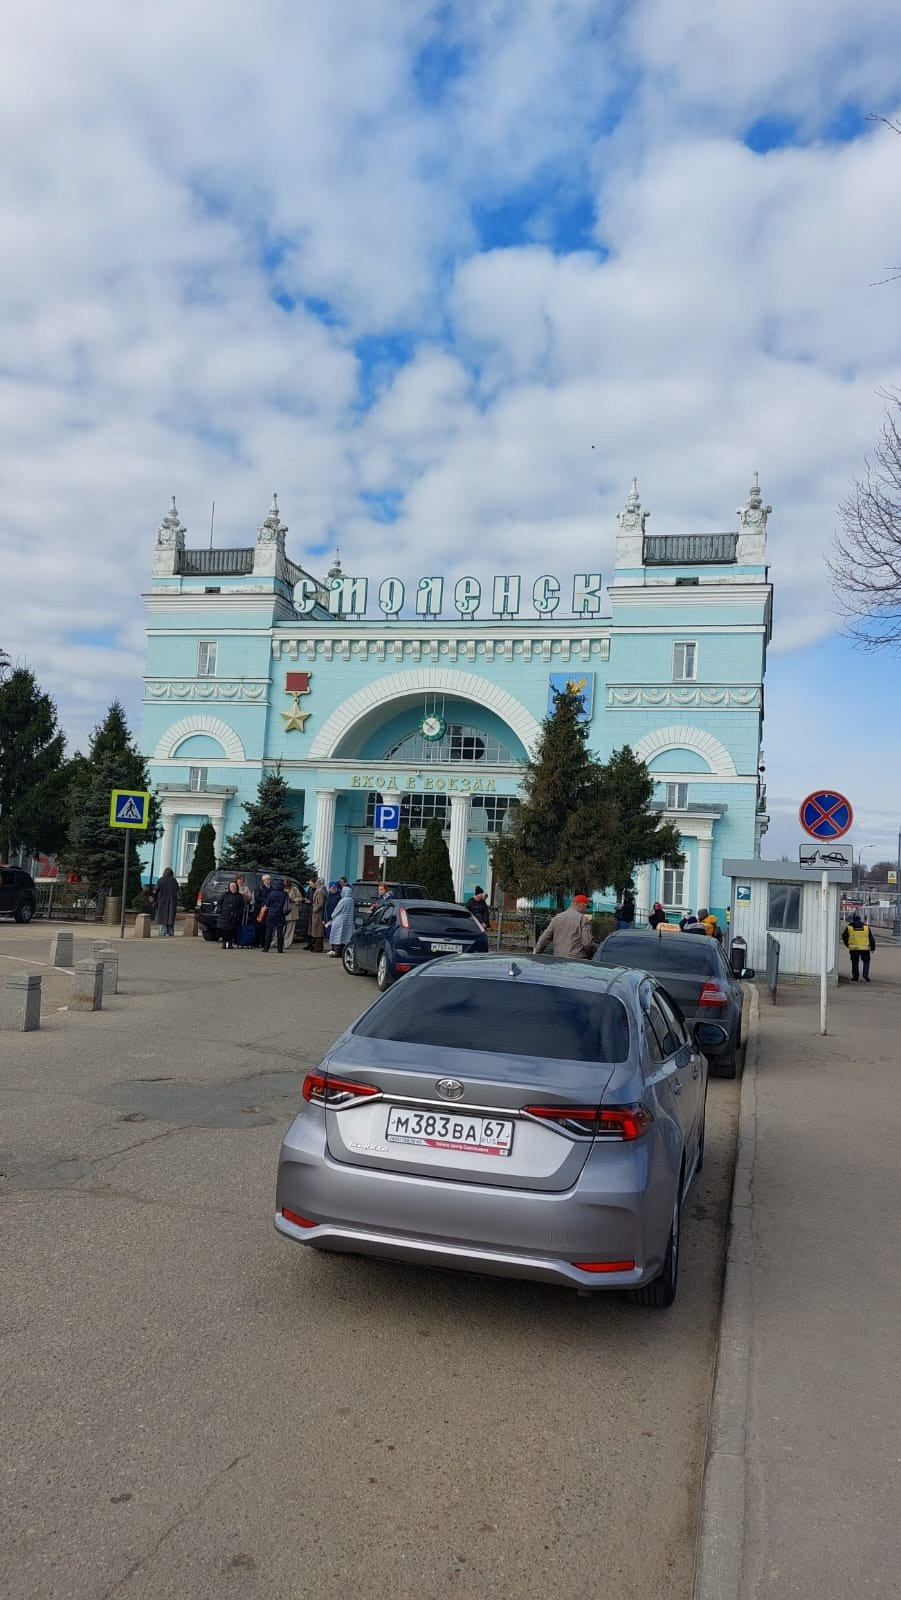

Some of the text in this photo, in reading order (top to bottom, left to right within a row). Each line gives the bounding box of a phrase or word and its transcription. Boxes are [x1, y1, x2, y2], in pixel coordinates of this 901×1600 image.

[293, 574, 602, 614] СМОЛЕНСК
[351, 775, 496, 792] ВХОД В ВОКЗАЛ
[395, 1113, 505, 1142] М383ВА 67
